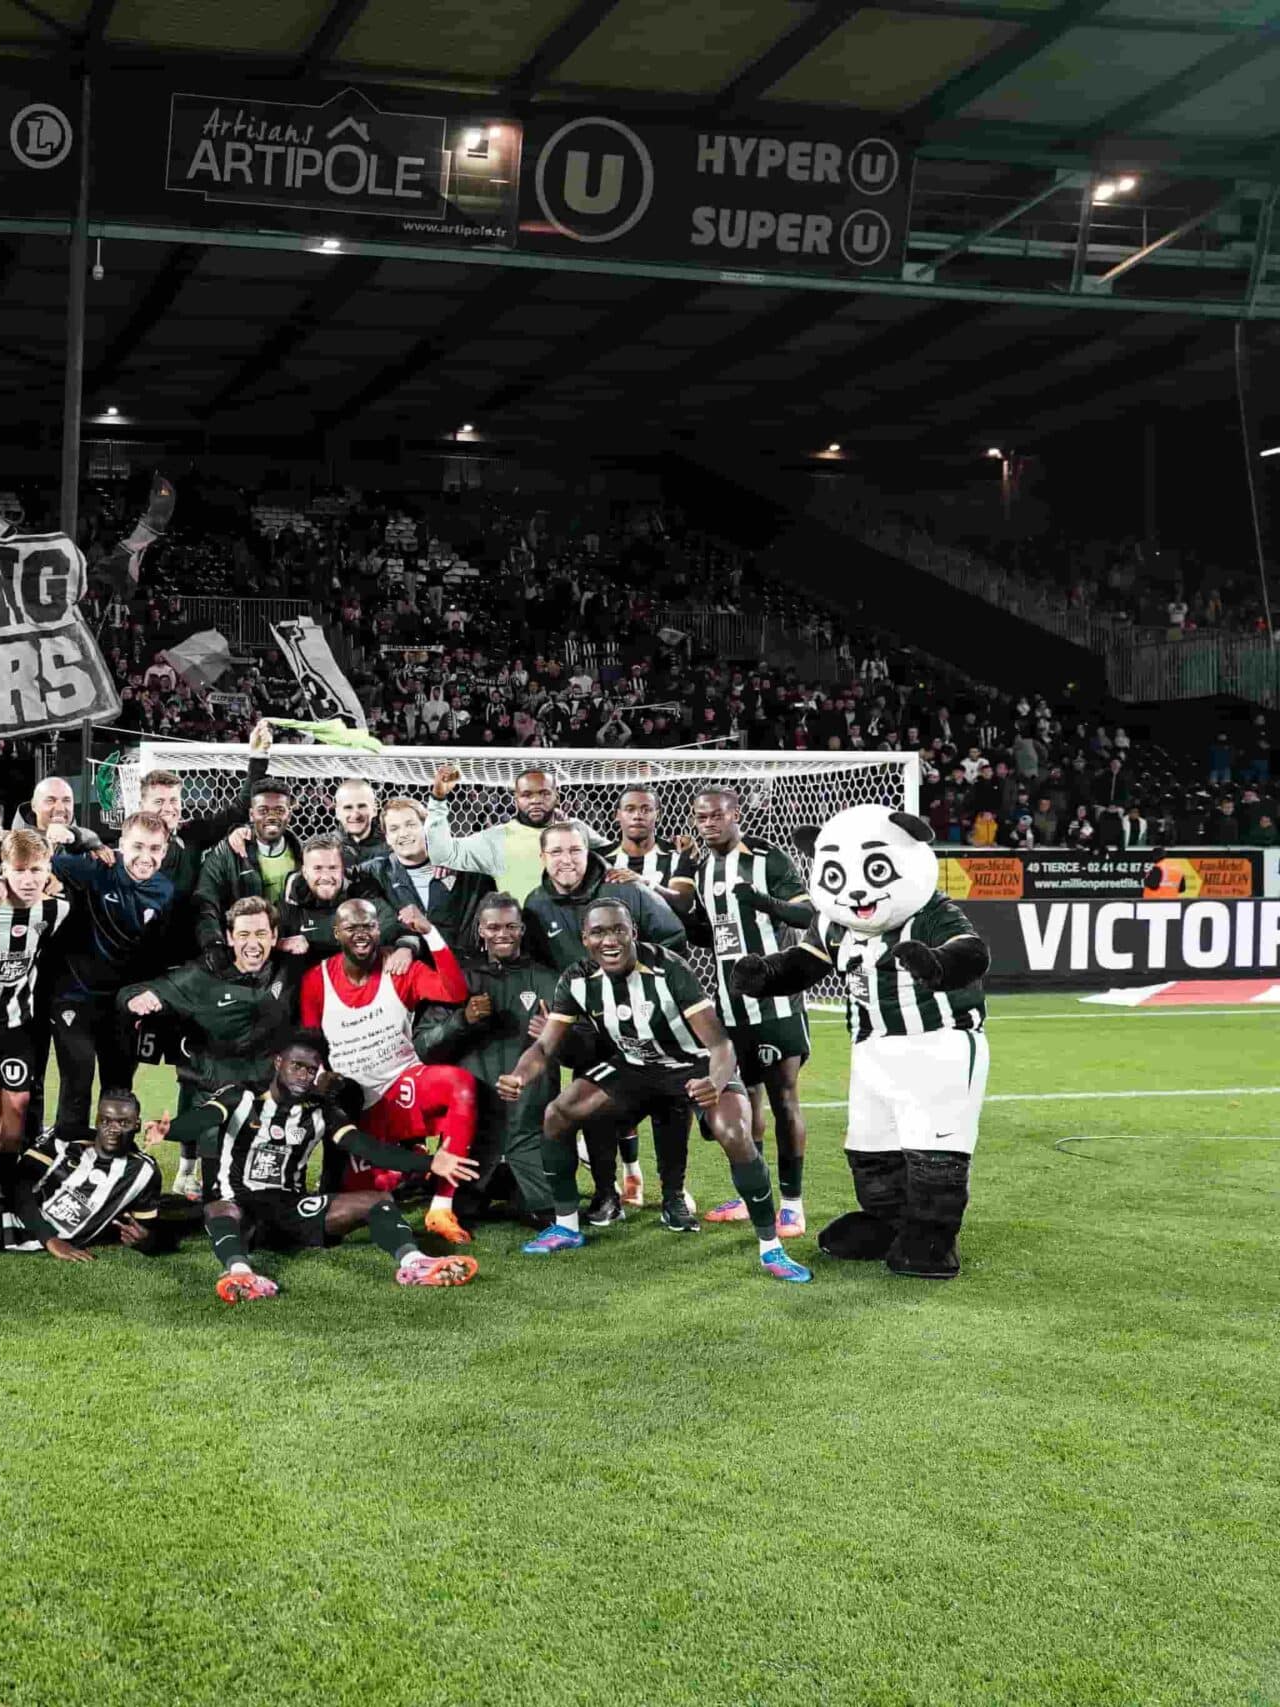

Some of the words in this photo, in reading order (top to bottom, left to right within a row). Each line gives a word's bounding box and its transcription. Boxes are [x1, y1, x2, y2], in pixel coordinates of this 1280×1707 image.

[203, 107, 315, 146] Artisans
[186, 115, 426, 199] ARTIPÔLE
[696, 134, 842, 185] HYPER
[860, 154, 888, 183] U
[563, 149, 625, 215] U
[402, 221, 508, 239] www.artipole.fr
[690, 205, 832, 255] SUPER
[852, 224, 880, 253] U
[974, 872, 1020, 887] MILLION
[1027, 862, 1040, 873] 49
[1041, 862, 1080, 873] TIERCE
[1087, 862, 1101, 873] 02
[1102, 862, 1114, 873] 41
[1116, 862, 1129, 873] 42
